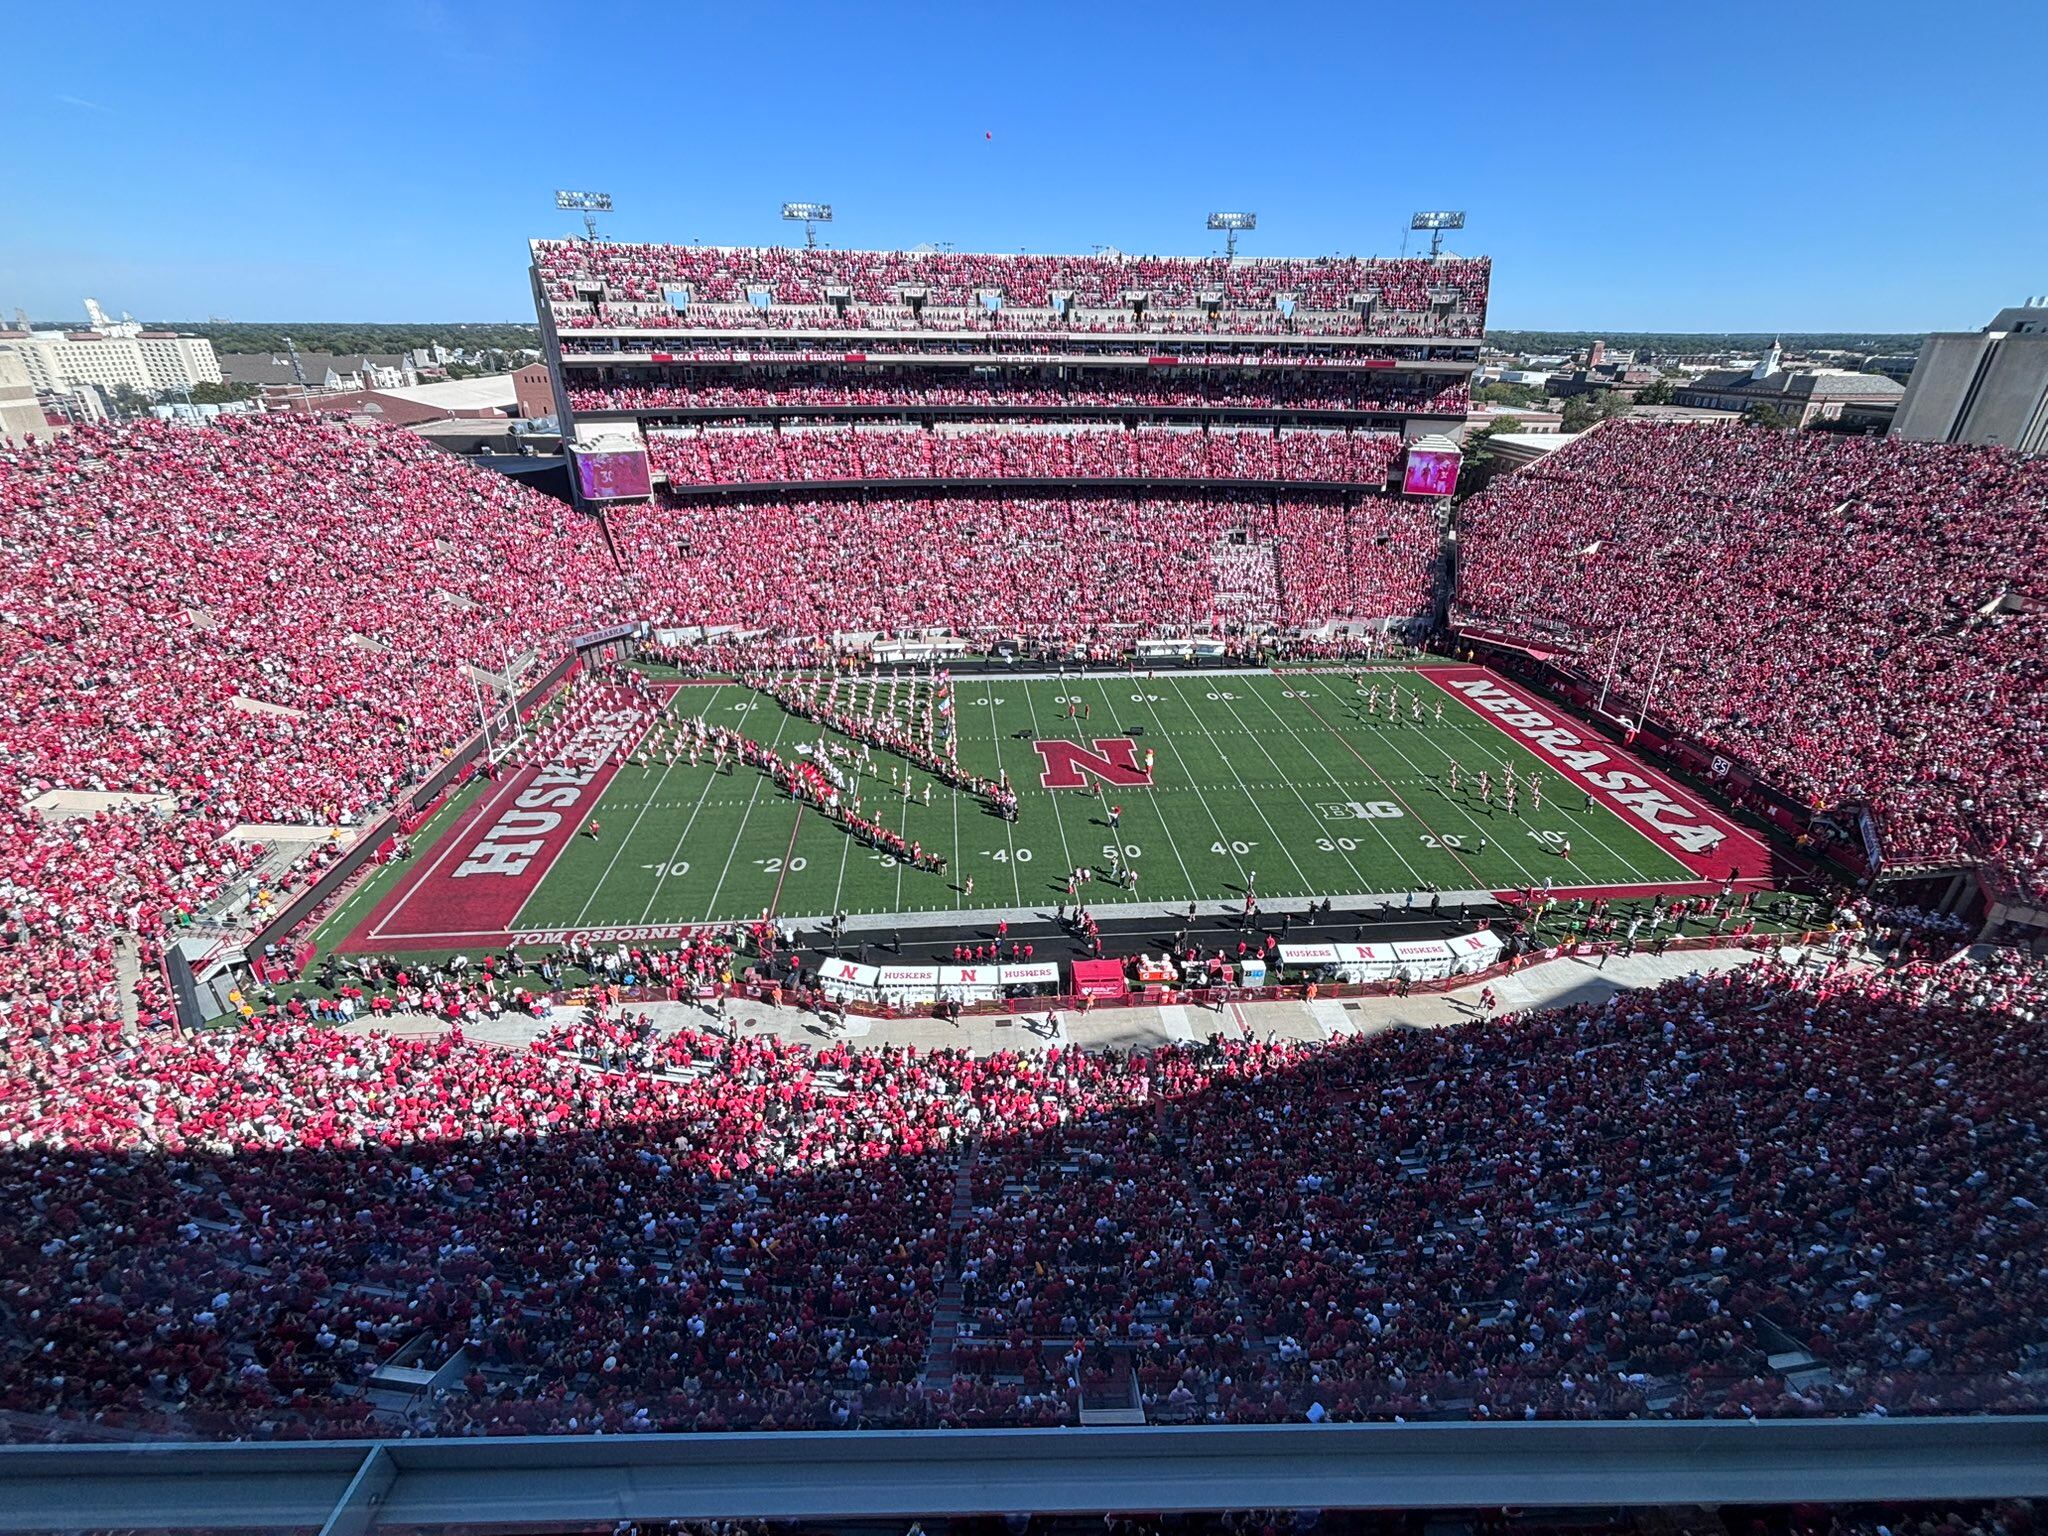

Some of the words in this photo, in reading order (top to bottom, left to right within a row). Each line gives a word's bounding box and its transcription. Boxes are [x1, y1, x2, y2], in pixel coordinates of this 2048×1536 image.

[672, 353, 695, 361] NCAA
[699, 353, 730, 361] RECORD
[753, 353, 806, 361] CONSECUTIVE
[809, 353, 845, 361] SELLOUTS
[1208, 357, 1240, 365] LEADING
[1262, 358, 1301, 366] ACADEMIC
[1321, 360, 1366, 368] AMERICANS
[582, 627, 625, 644] NEBRASKA
[1033, 738, 1154, 788] N
[1448, 679, 1727, 853] NEBRASKA
[1714, 758, 1728, 773] 25
[1315, 836, 1357, 852] 30
[1419, 833, 1463, 849] 20
[1526, 829, 1566, 844] 10
[1102, 844, 1142, 860] 50
[1210, 840, 1250, 855] 40
[993, 848, 1032, 863] 40
[655, 861, 690, 877] 10
[763, 857, 807, 873] 20
[512, 931, 567, 945] TOM
[572, 926, 680, 943] OSBORNE
[1399, 946, 1446, 956] HUSKERS
[1467, 937, 1485, 950] N
[1285, 949, 1331, 959] HUSKERS
[1356, 946, 1375, 958] N
[839, 965, 858, 980] N
[884, 971, 933, 981] HUSKERS
[961, 969, 977, 982] N
[1004, 968, 1053, 979] HUSKERS
